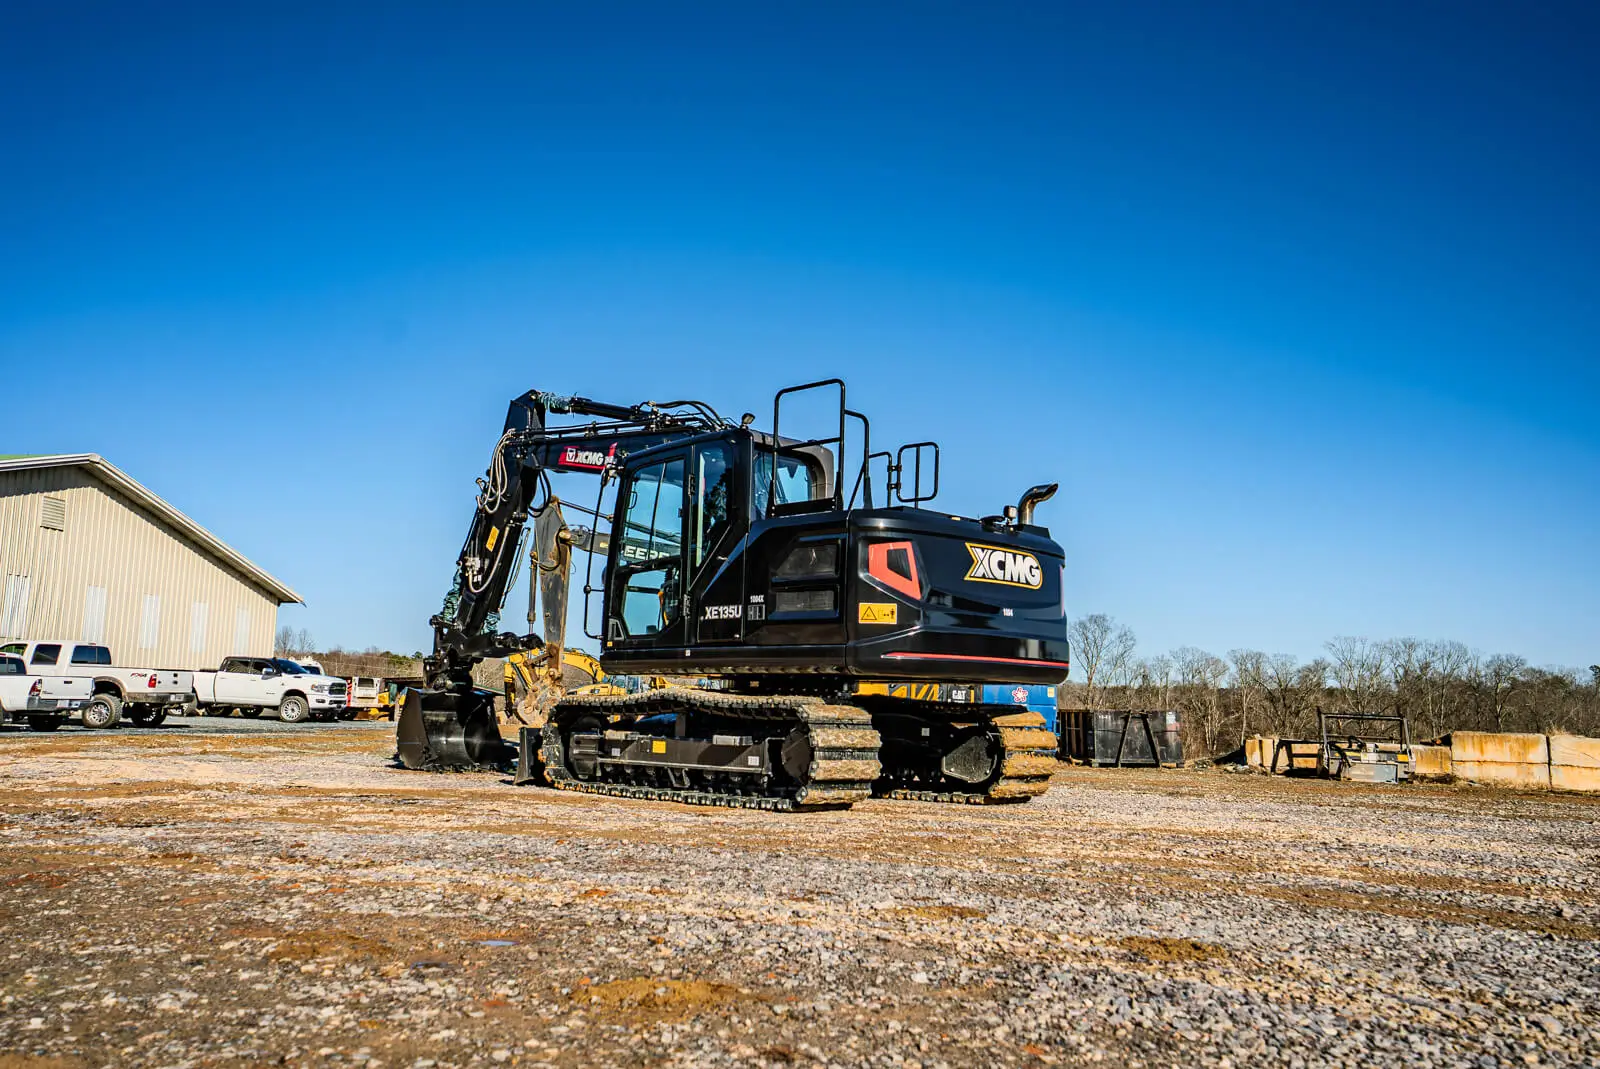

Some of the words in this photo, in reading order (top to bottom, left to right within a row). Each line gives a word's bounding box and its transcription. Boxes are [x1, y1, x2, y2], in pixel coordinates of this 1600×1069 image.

[575, 450, 604, 465] XCMG
[970, 547, 1041, 586] XCMG
[705, 605, 742, 620] XE135U
[952, 690, 967, 700] CAT
